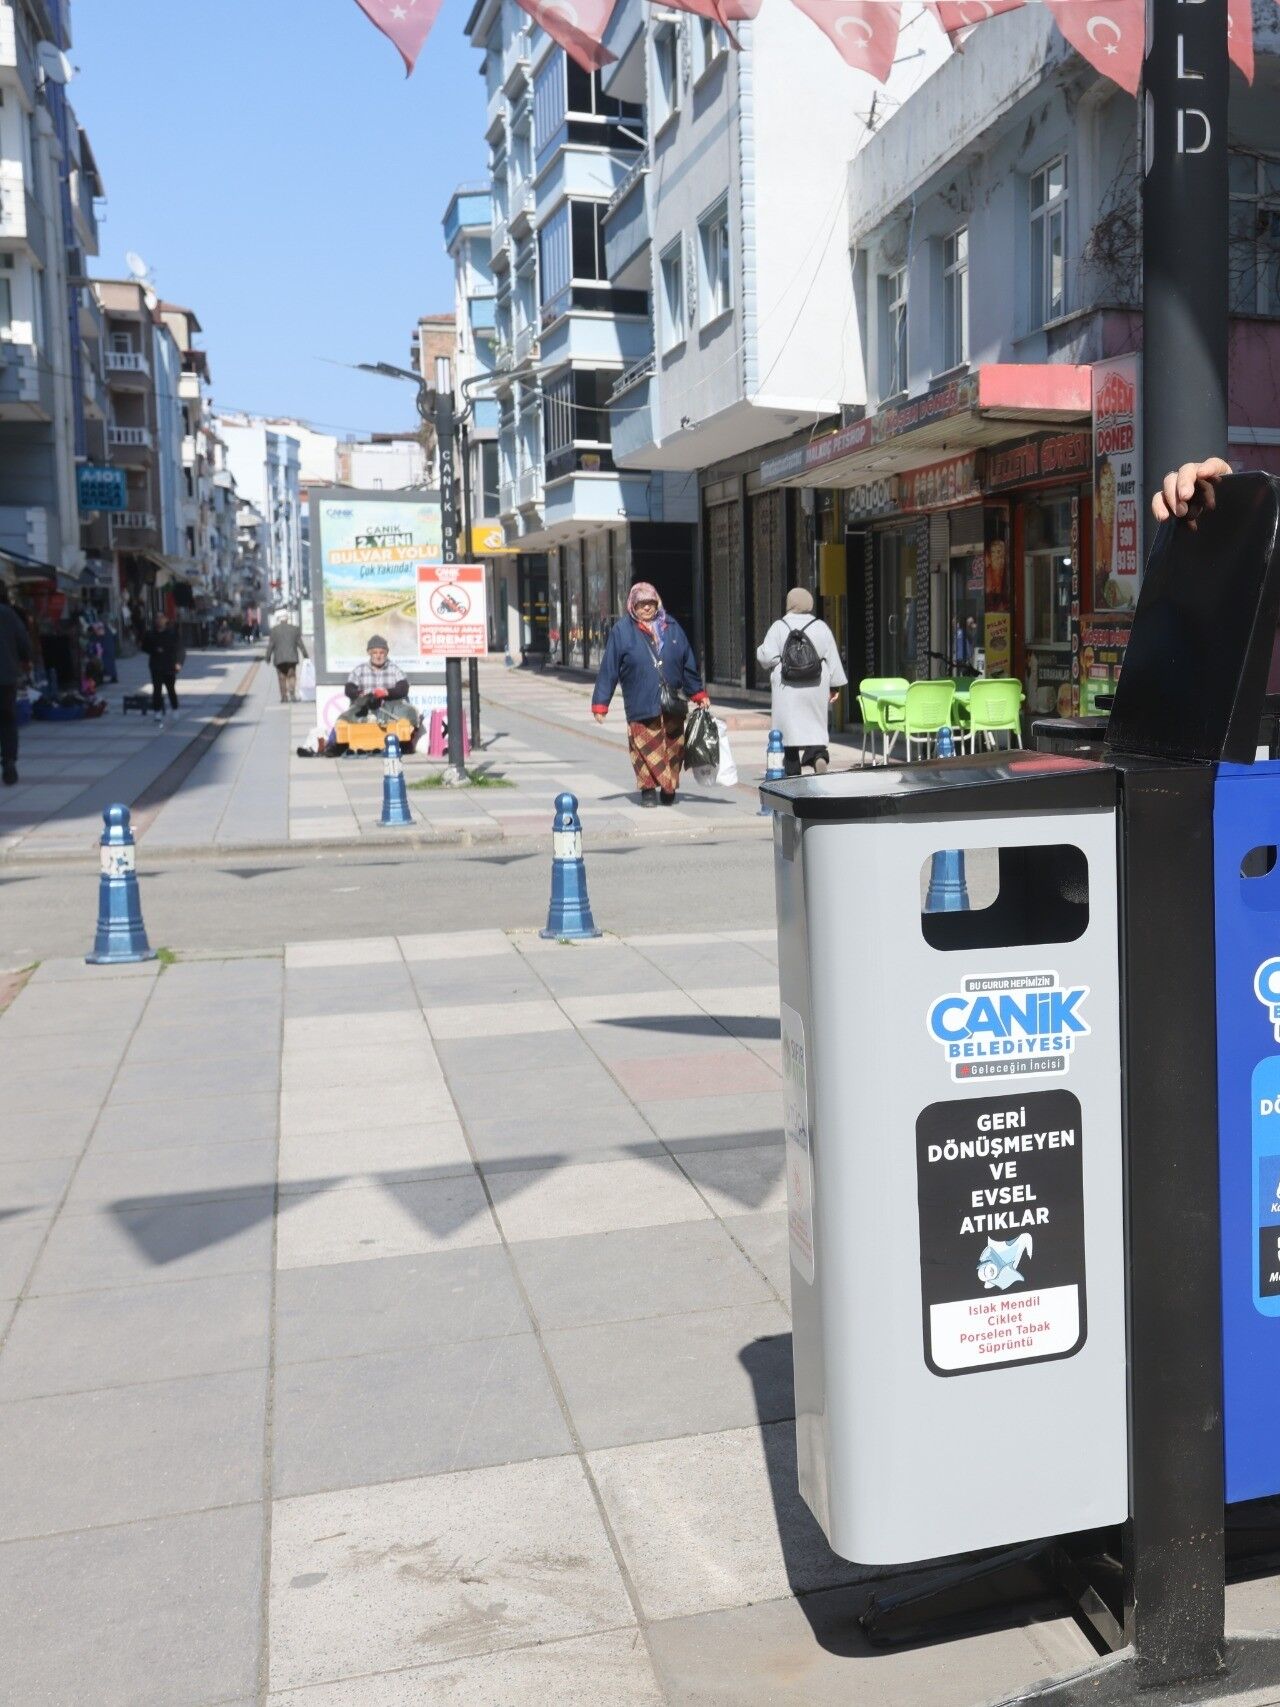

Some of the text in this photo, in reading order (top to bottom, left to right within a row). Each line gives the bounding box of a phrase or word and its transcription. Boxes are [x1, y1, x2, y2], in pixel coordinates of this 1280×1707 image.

[1178, 0, 1211, 154] LD
[969, 976, 1050, 991] BU GURUR HEPİMİZİN
[977, 1106, 1026, 1133] GERİ
[928, 1130, 1075, 1164] DÖNÜŞMEYEN
[989, 1161, 1017, 1182] VE
[971, 1185, 1037, 1209] EVSEL
[959, 1209, 1050, 1236] ATIKLAR
[969, 1296, 1041, 1316] Islak Mendil
[988, 1313, 1023, 1326] Ciklet
[960, 1321, 1051, 1343] Porselen Tabak
[979, 1337, 1033, 1354] Süprüntü
